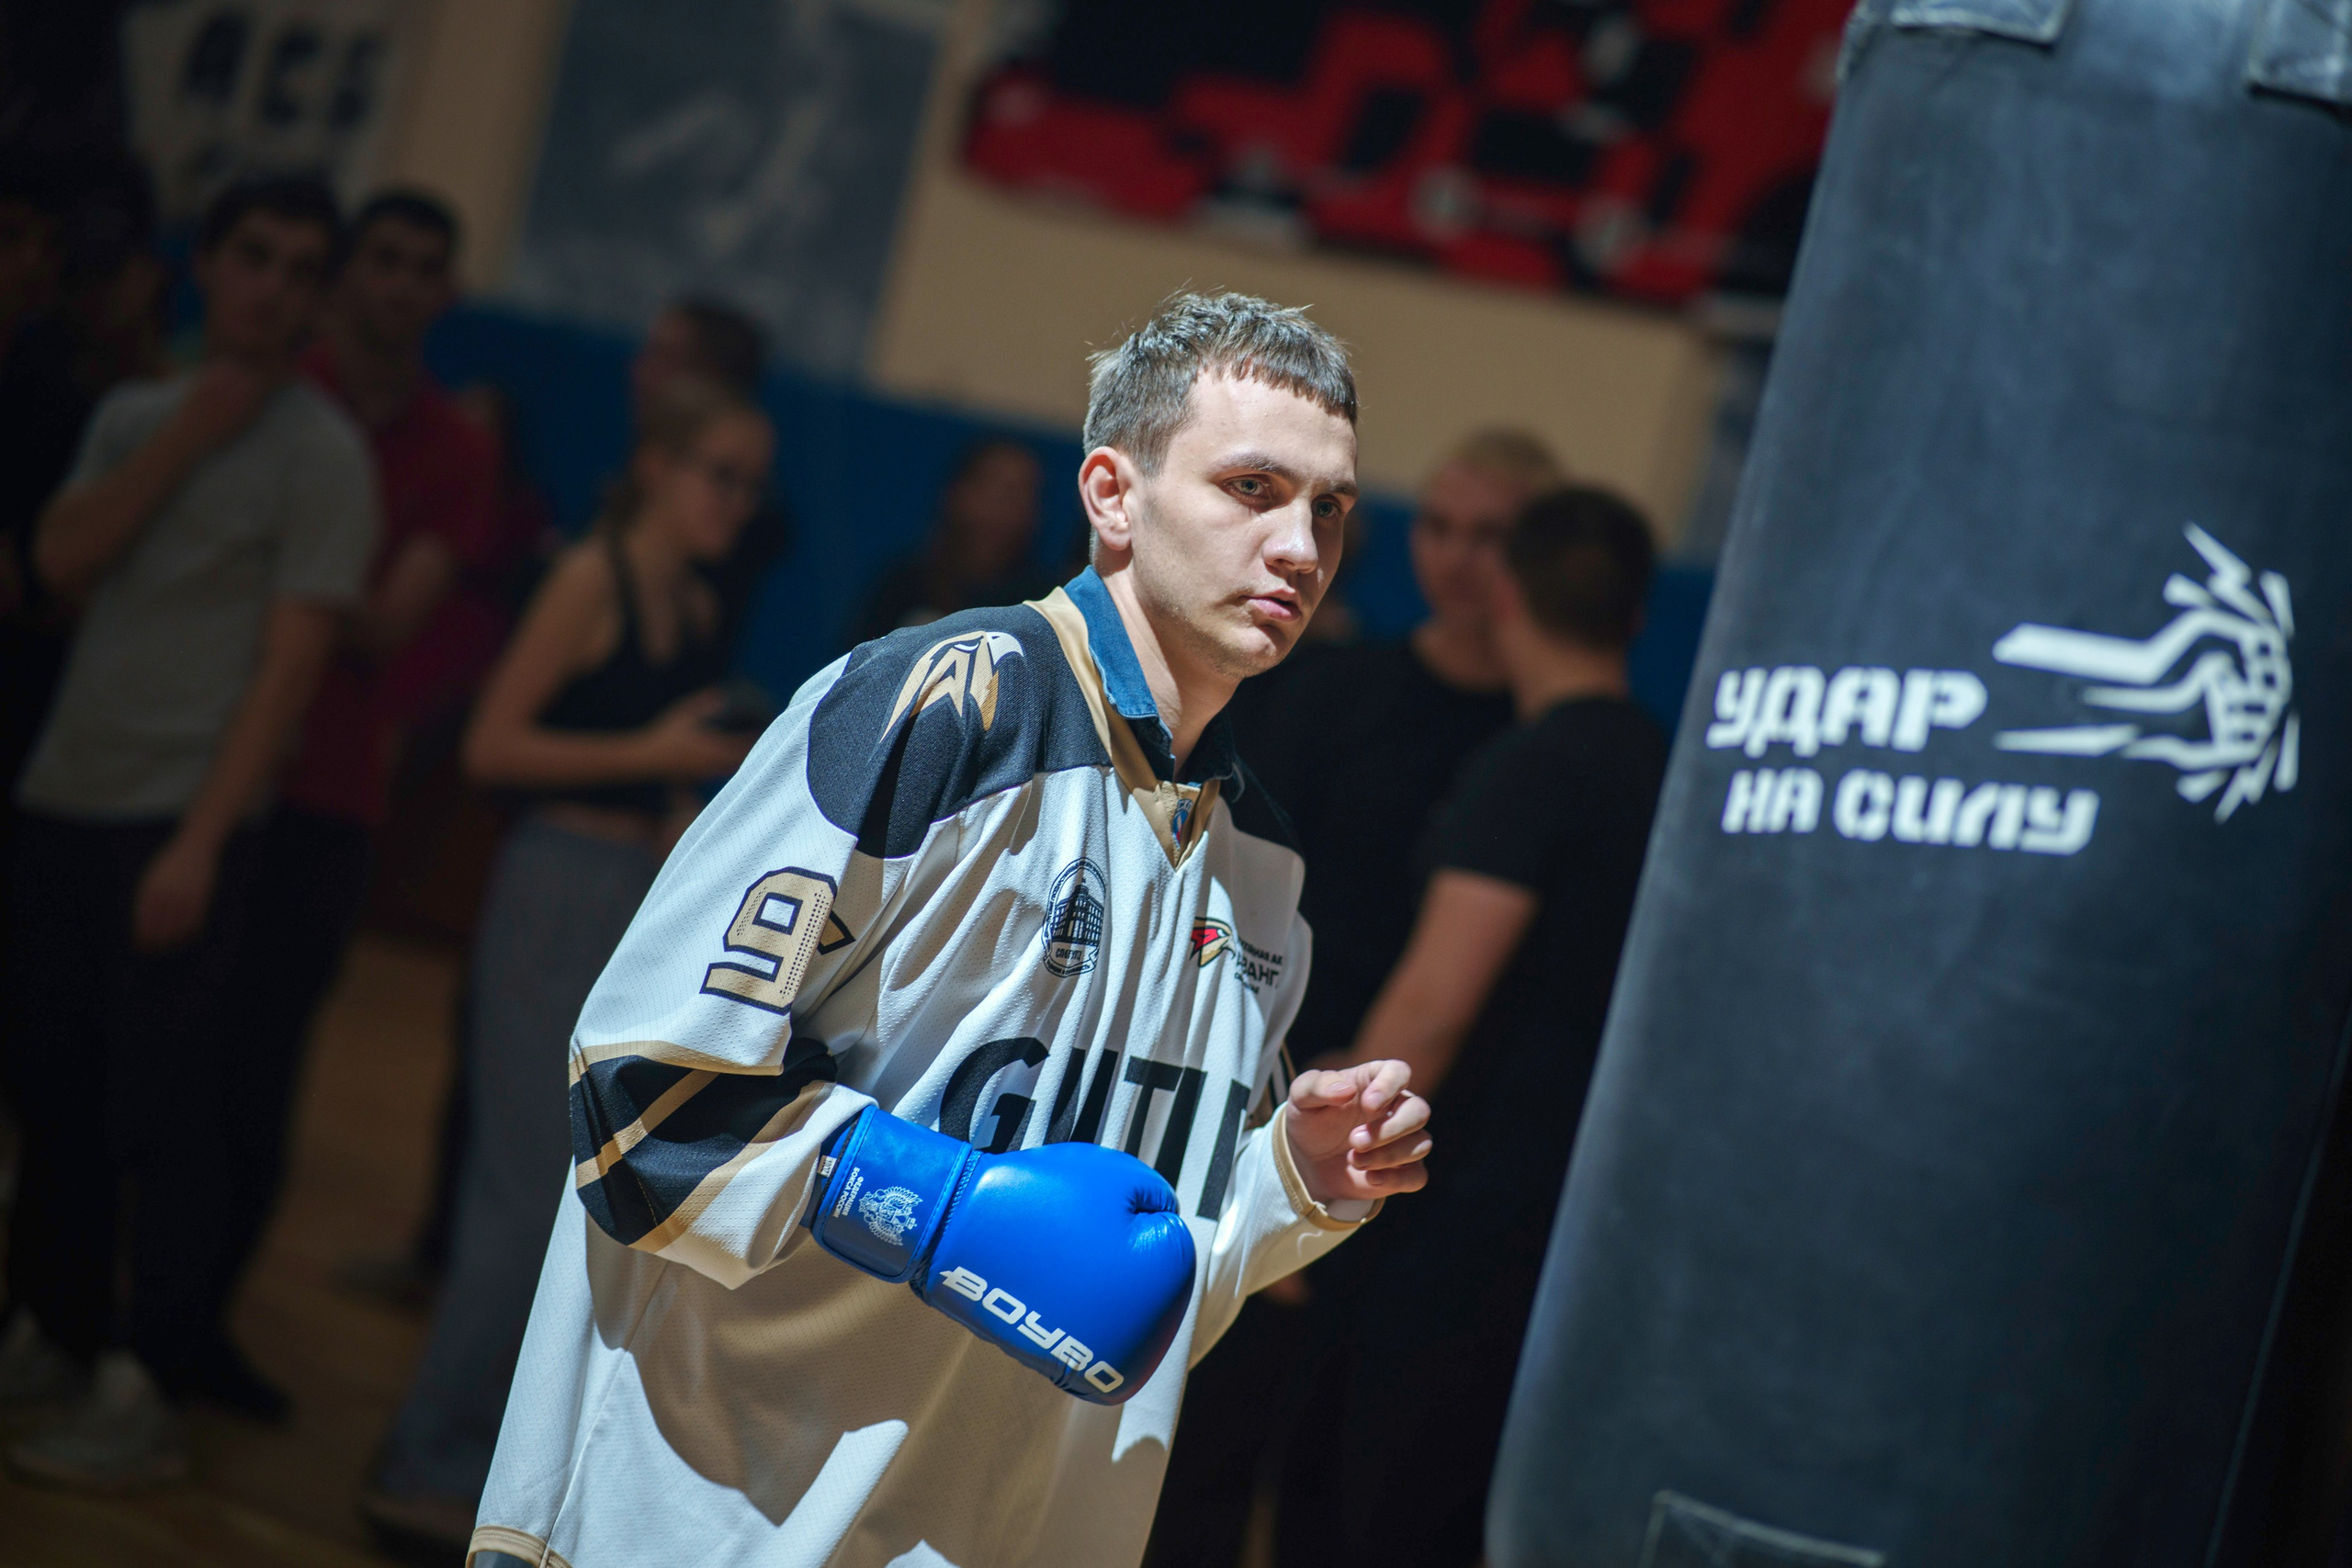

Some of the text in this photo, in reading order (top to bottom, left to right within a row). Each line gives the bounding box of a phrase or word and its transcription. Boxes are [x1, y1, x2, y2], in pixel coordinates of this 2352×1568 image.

[1706, 665, 1988, 758] УДАР
[1721, 767, 2101, 855] НА СИЛУ
[699, 866, 855, 1015] 9
[844, 1167, 861, 1191] БОКСА
[939, 1266, 1125, 1393] BOYBO
